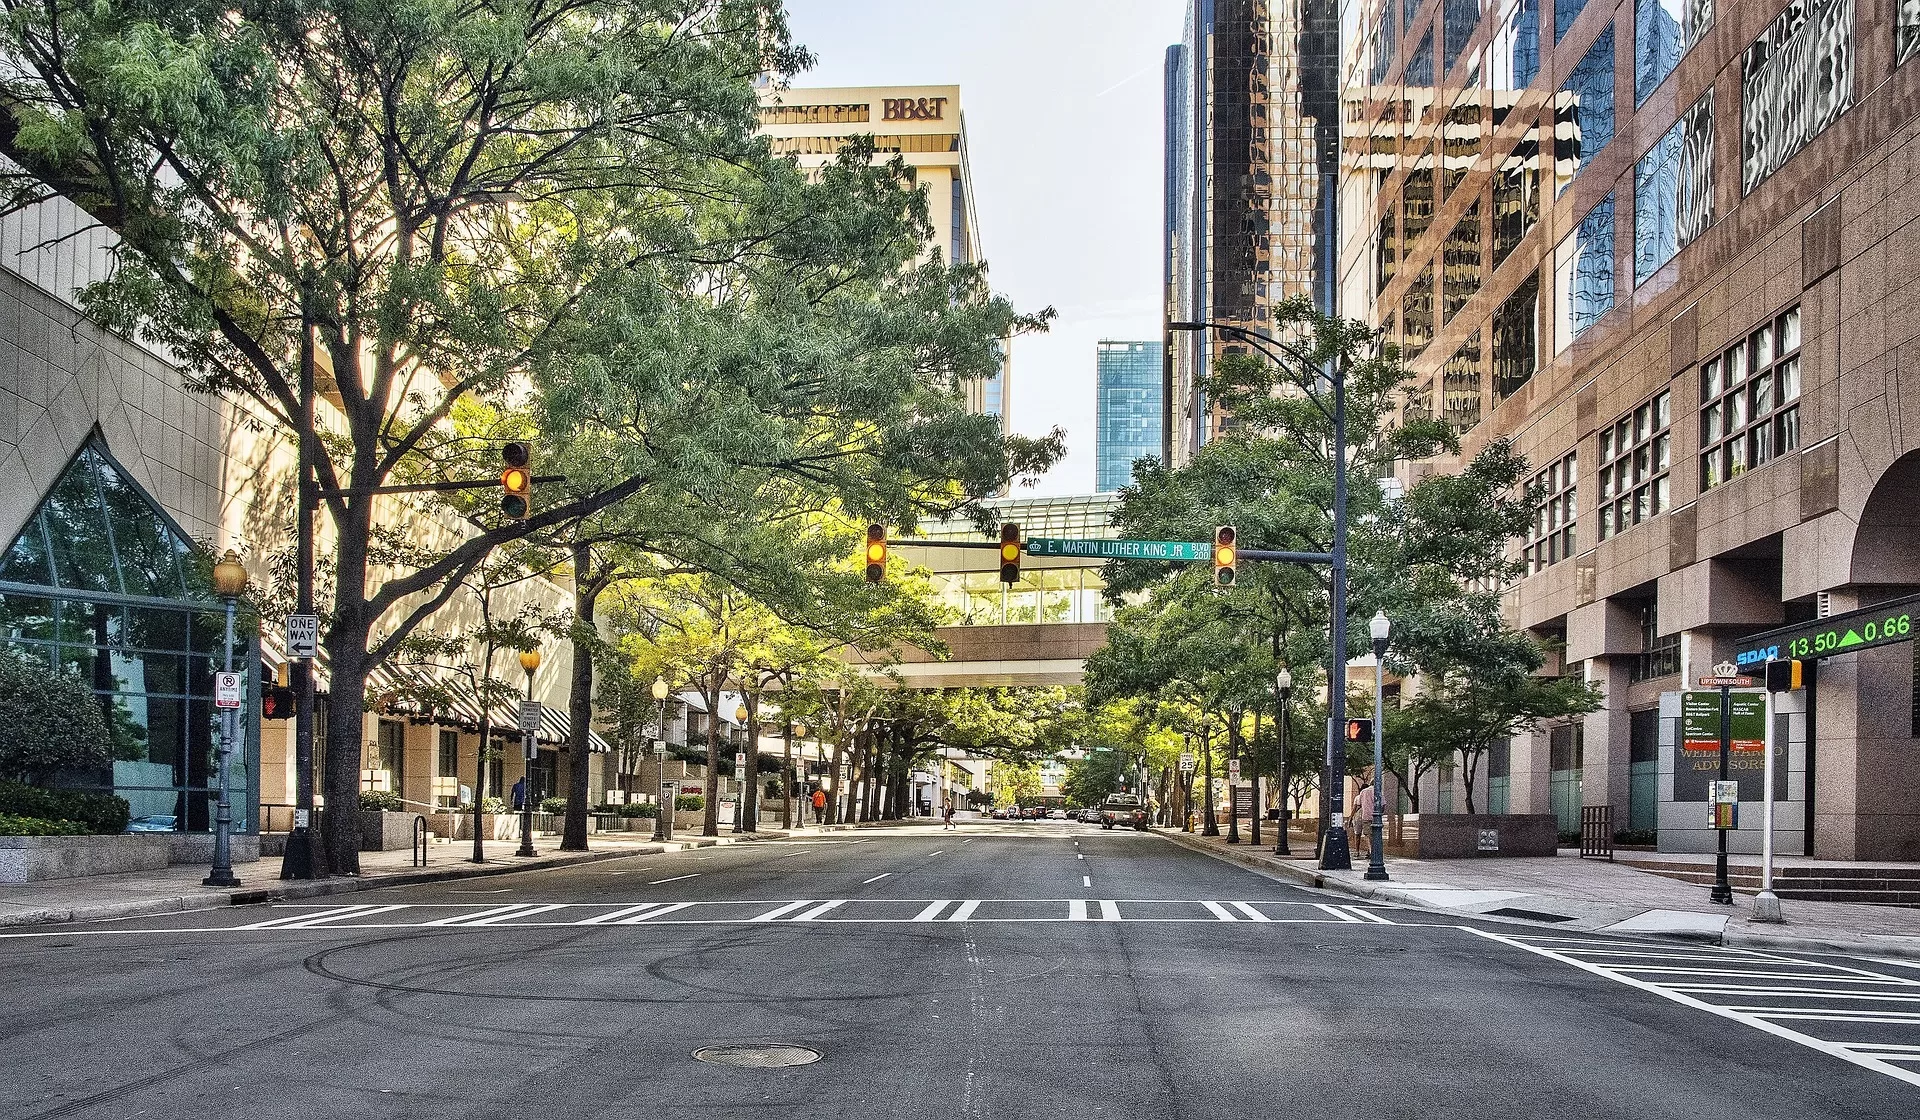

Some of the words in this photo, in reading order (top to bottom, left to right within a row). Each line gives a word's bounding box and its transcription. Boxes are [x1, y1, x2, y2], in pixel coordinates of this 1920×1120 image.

[881, 97, 947, 121] BB&T
[1047, 541, 1058, 553] E.
[1062, 541, 1098, 554] MARTIN
[1102, 542, 1140, 555] LUTHER
[1143, 543, 1167, 556] KING
[1170, 544, 1184, 557] JR
[1191, 543, 1209, 551] BLVD
[1193, 551, 1209, 560] 200
[291, 619, 314, 629] ONE
[290, 631, 314, 640] WAY
[1788, 631, 1838, 657] 13.50
[1864, 614, 1910, 642] 0.66
[1182, 761, 1193, 769] 25
[1692, 760, 1765, 770] ADVSORS
